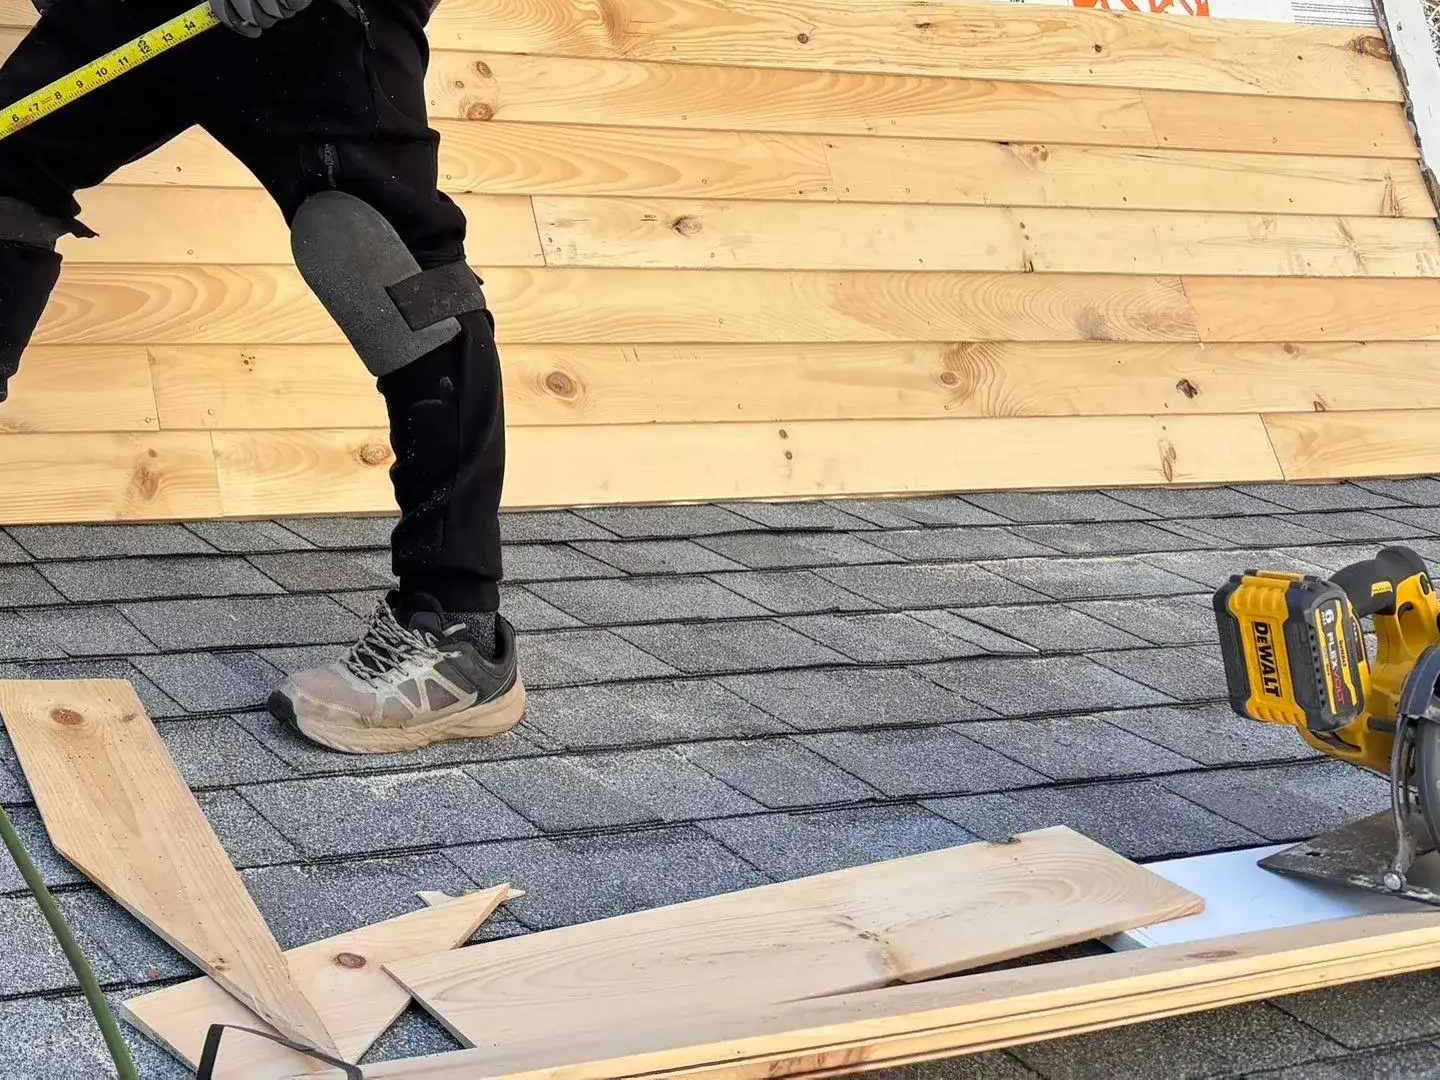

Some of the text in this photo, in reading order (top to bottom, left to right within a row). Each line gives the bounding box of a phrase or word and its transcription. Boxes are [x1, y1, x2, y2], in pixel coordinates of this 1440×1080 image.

[11, 114, 20, 123] 6
[32, 102, 40, 112] 7
[54, 91, 63, 100] 8
[75, 80, 84, 89] 9
[95, 67, 108, 78] 10
[117, 56, 130, 67] 11
[138, 45, 152, 55] 12
[162, 32, 174, 43] 13
[184, 21, 196, 31] 14
